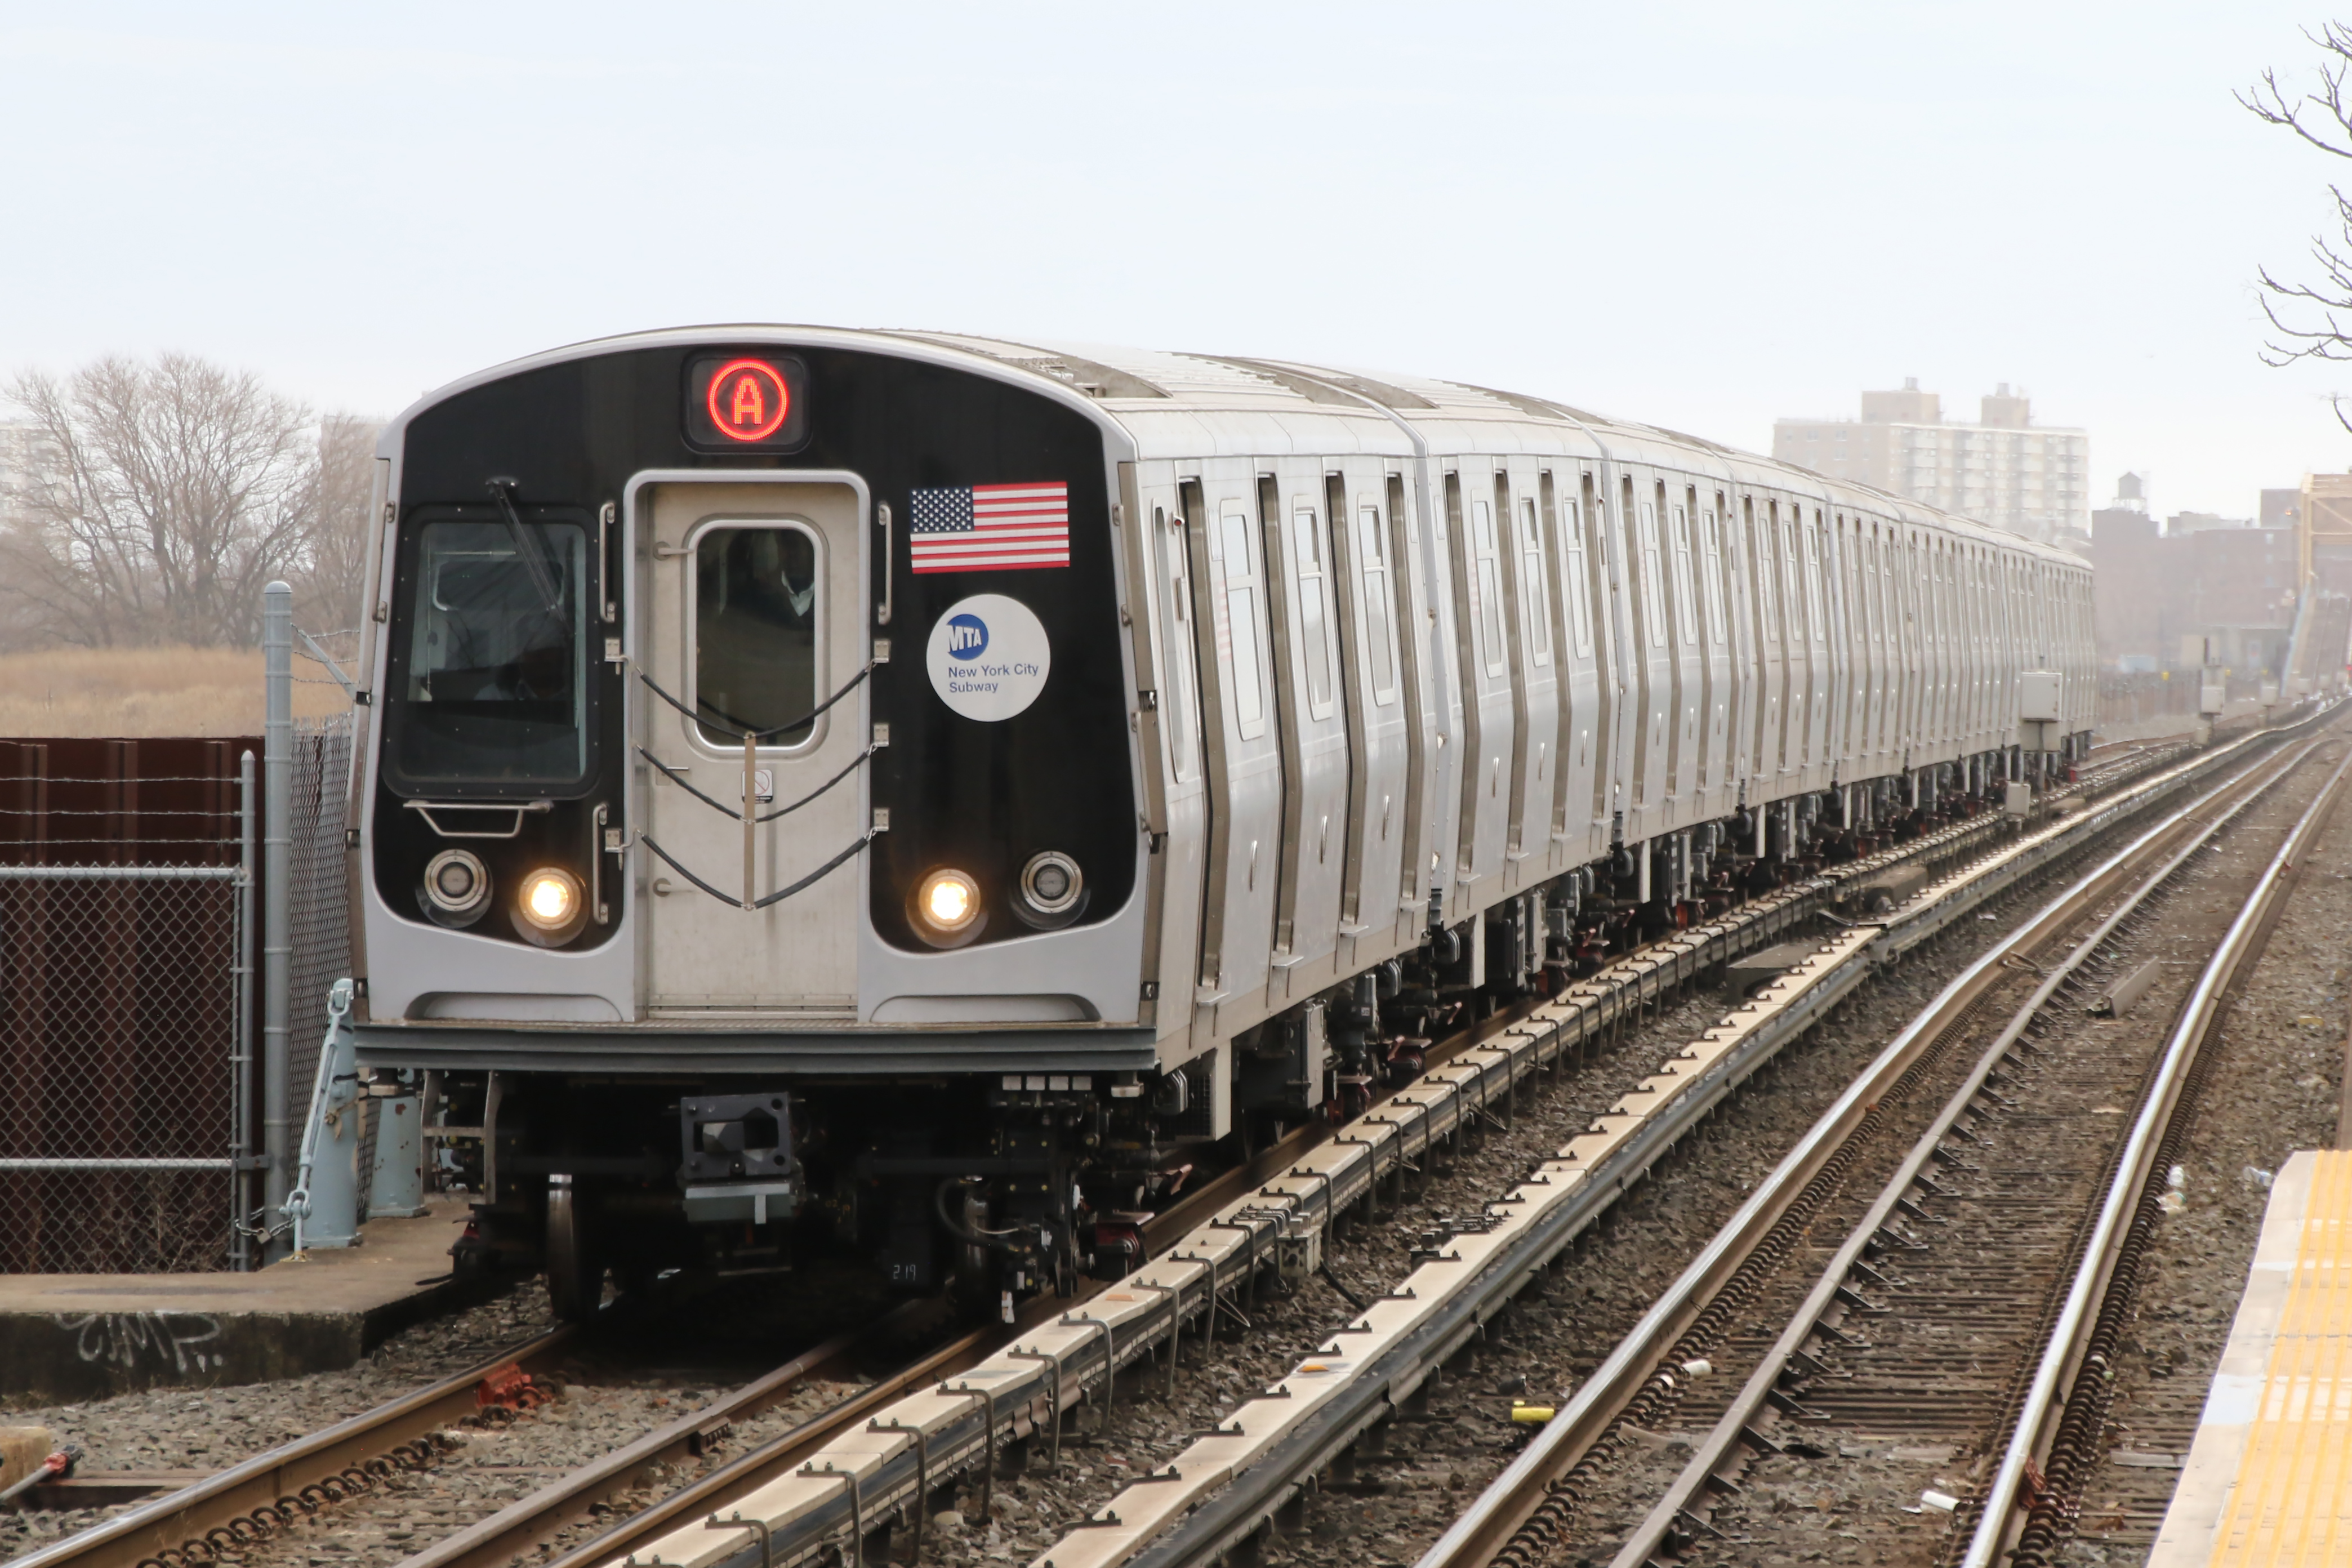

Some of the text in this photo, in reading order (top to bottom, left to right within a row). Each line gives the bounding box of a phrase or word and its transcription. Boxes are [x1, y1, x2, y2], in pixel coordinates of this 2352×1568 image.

[733, 377, 763, 425] A
[946, 625, 982, 652] MTA
[948, 663, 1039, 678] New York City
[949, 681, 998, 693] Subway
